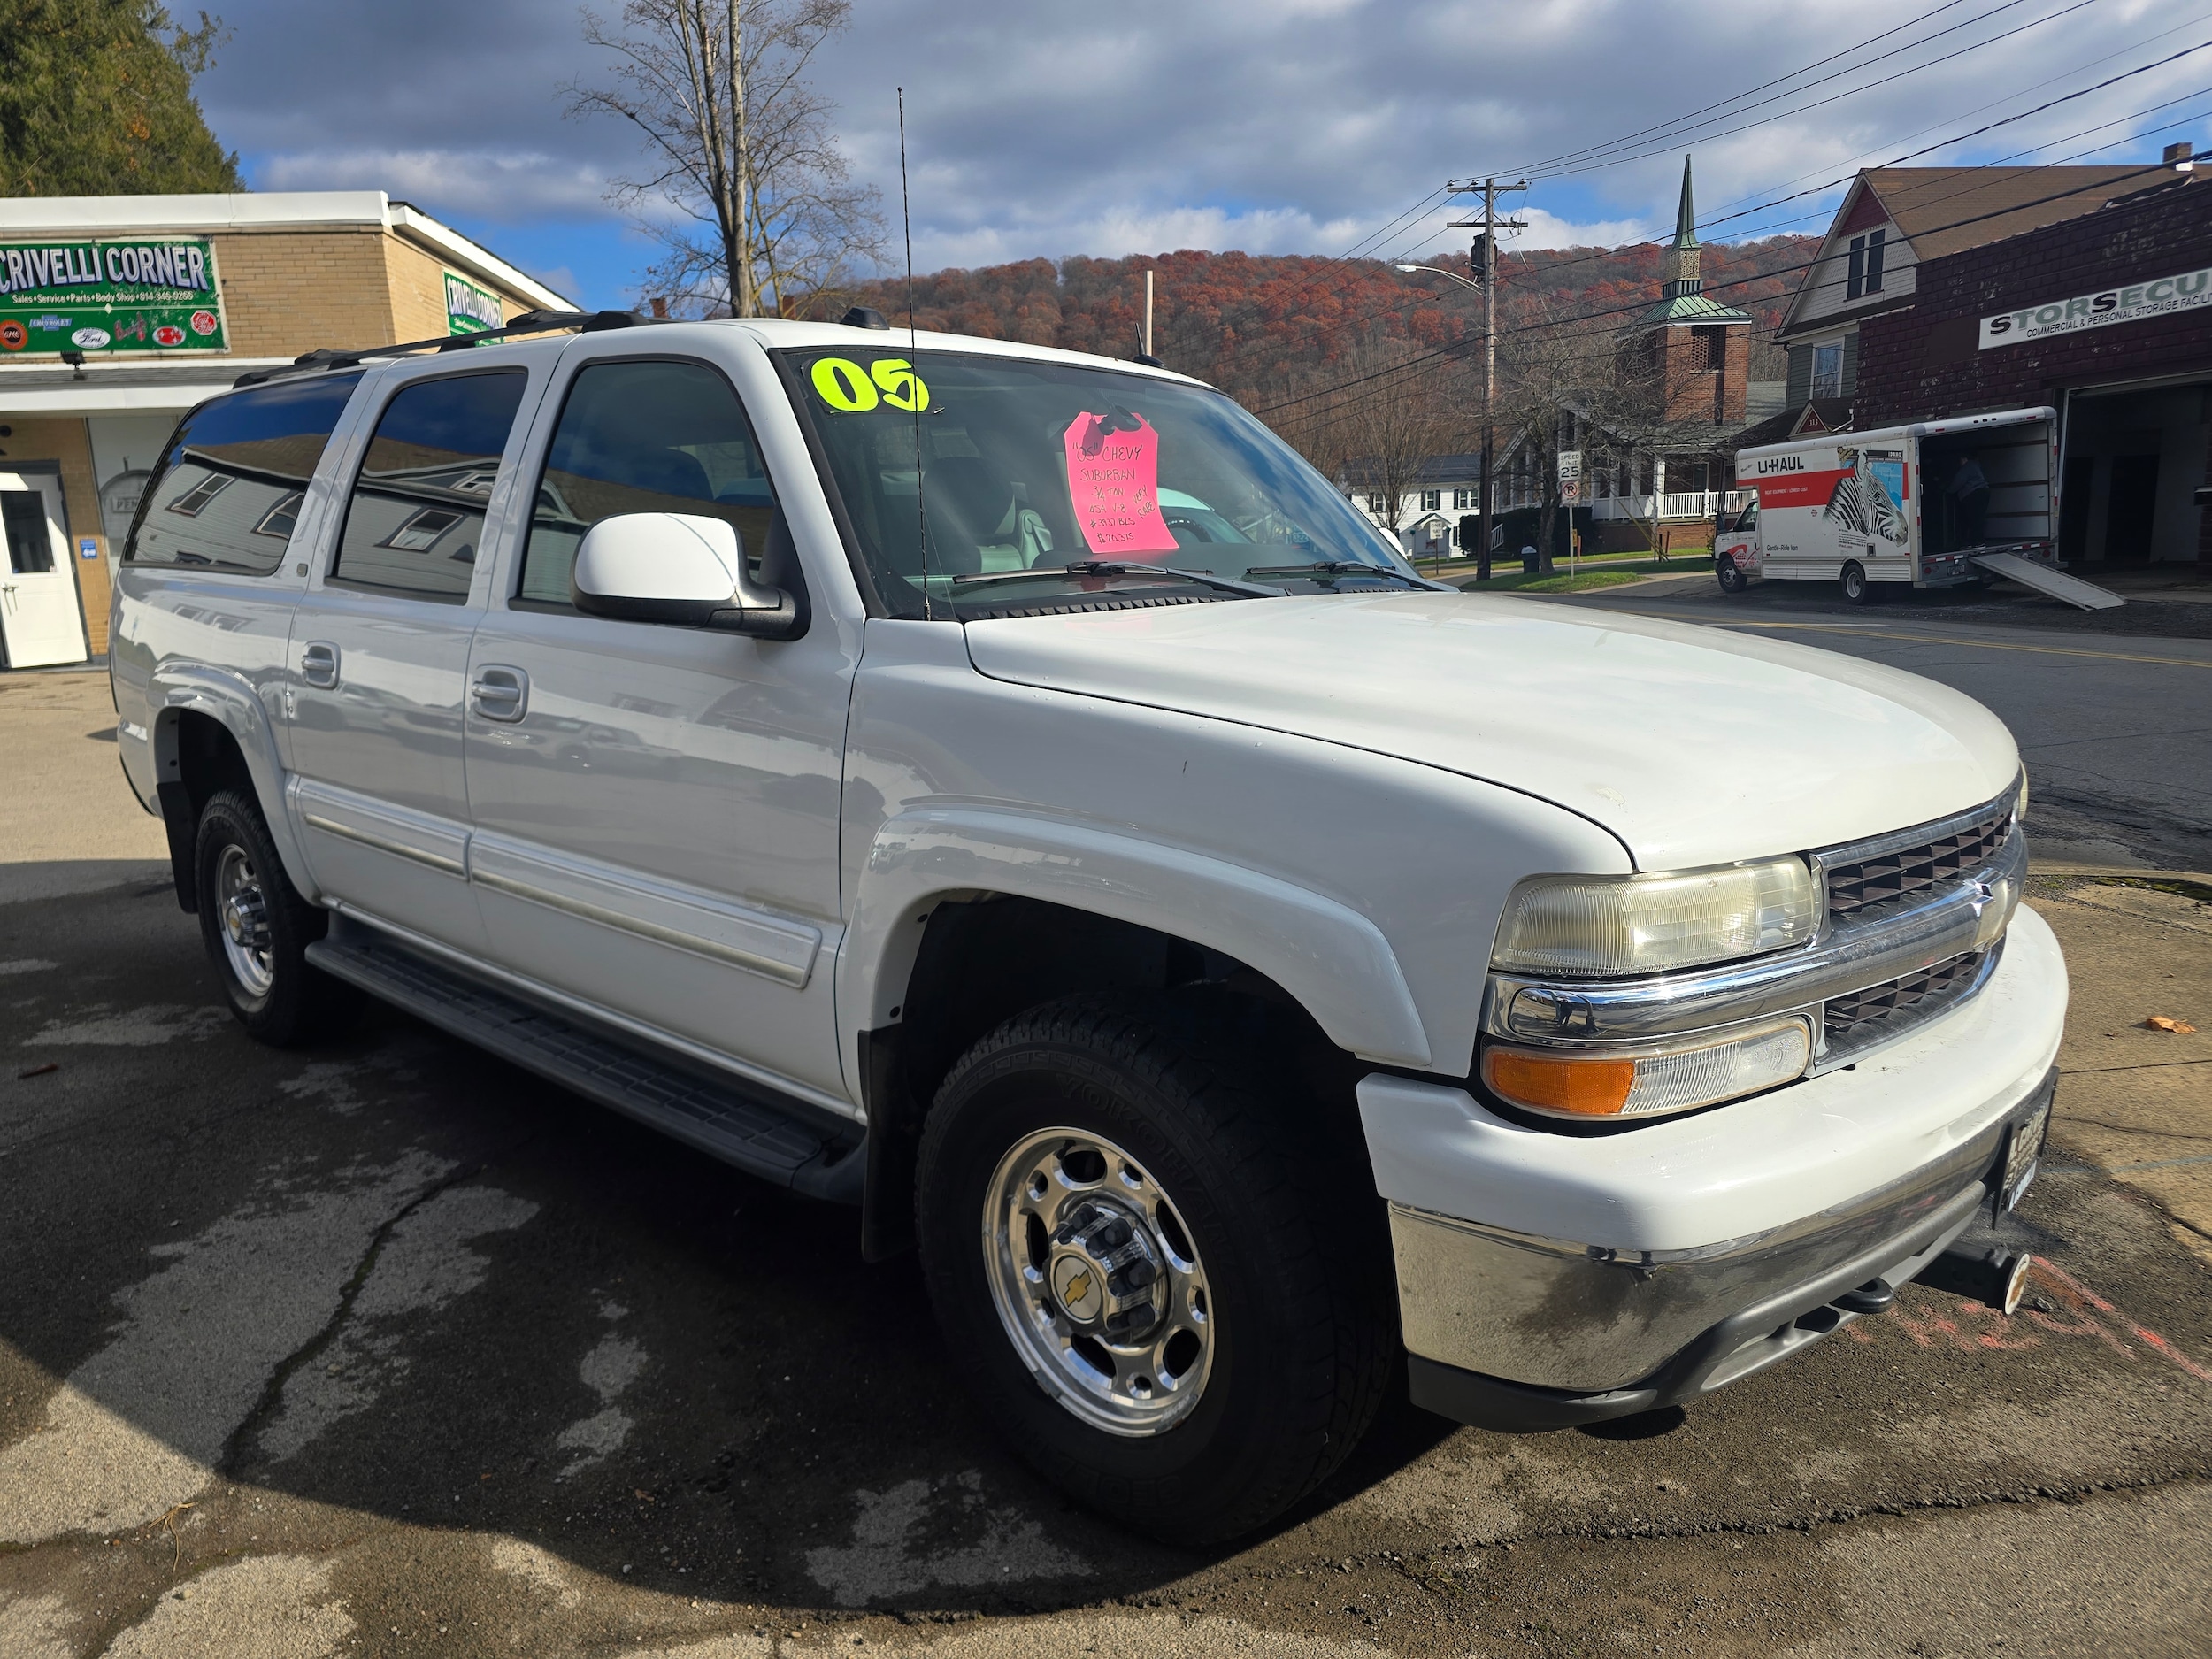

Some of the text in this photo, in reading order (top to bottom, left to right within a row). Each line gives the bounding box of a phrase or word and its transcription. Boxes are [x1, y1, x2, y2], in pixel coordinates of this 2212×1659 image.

[0, 247, 209, 294] CRIVELLI CORNER
[12, 294, 33, 304] Sales
[37, 293, 65, 303] Service
[70, 292, 91, 303] Parts
[95, 292, 115, 303] Body
[2026, 319, 2078, 338] COMMERCIAL
[2079, 319, 2085, 327] &
[2087, 309, 2133, 326] PERSONAL
[2135, 300, 2178, 317] STORAGE
[810, 357, 931, 412] 05
[1102, 445, 1143, 461] CHEVY
[1561, 466, 1579, 478] 25
[1758, 456, 1804, 474] U-HAUL
[1079, 467, 1135, 482] SUBURBAN
[1107, 487, 1124, 496] TON
[1133, 485, 1148, 504] VERY
